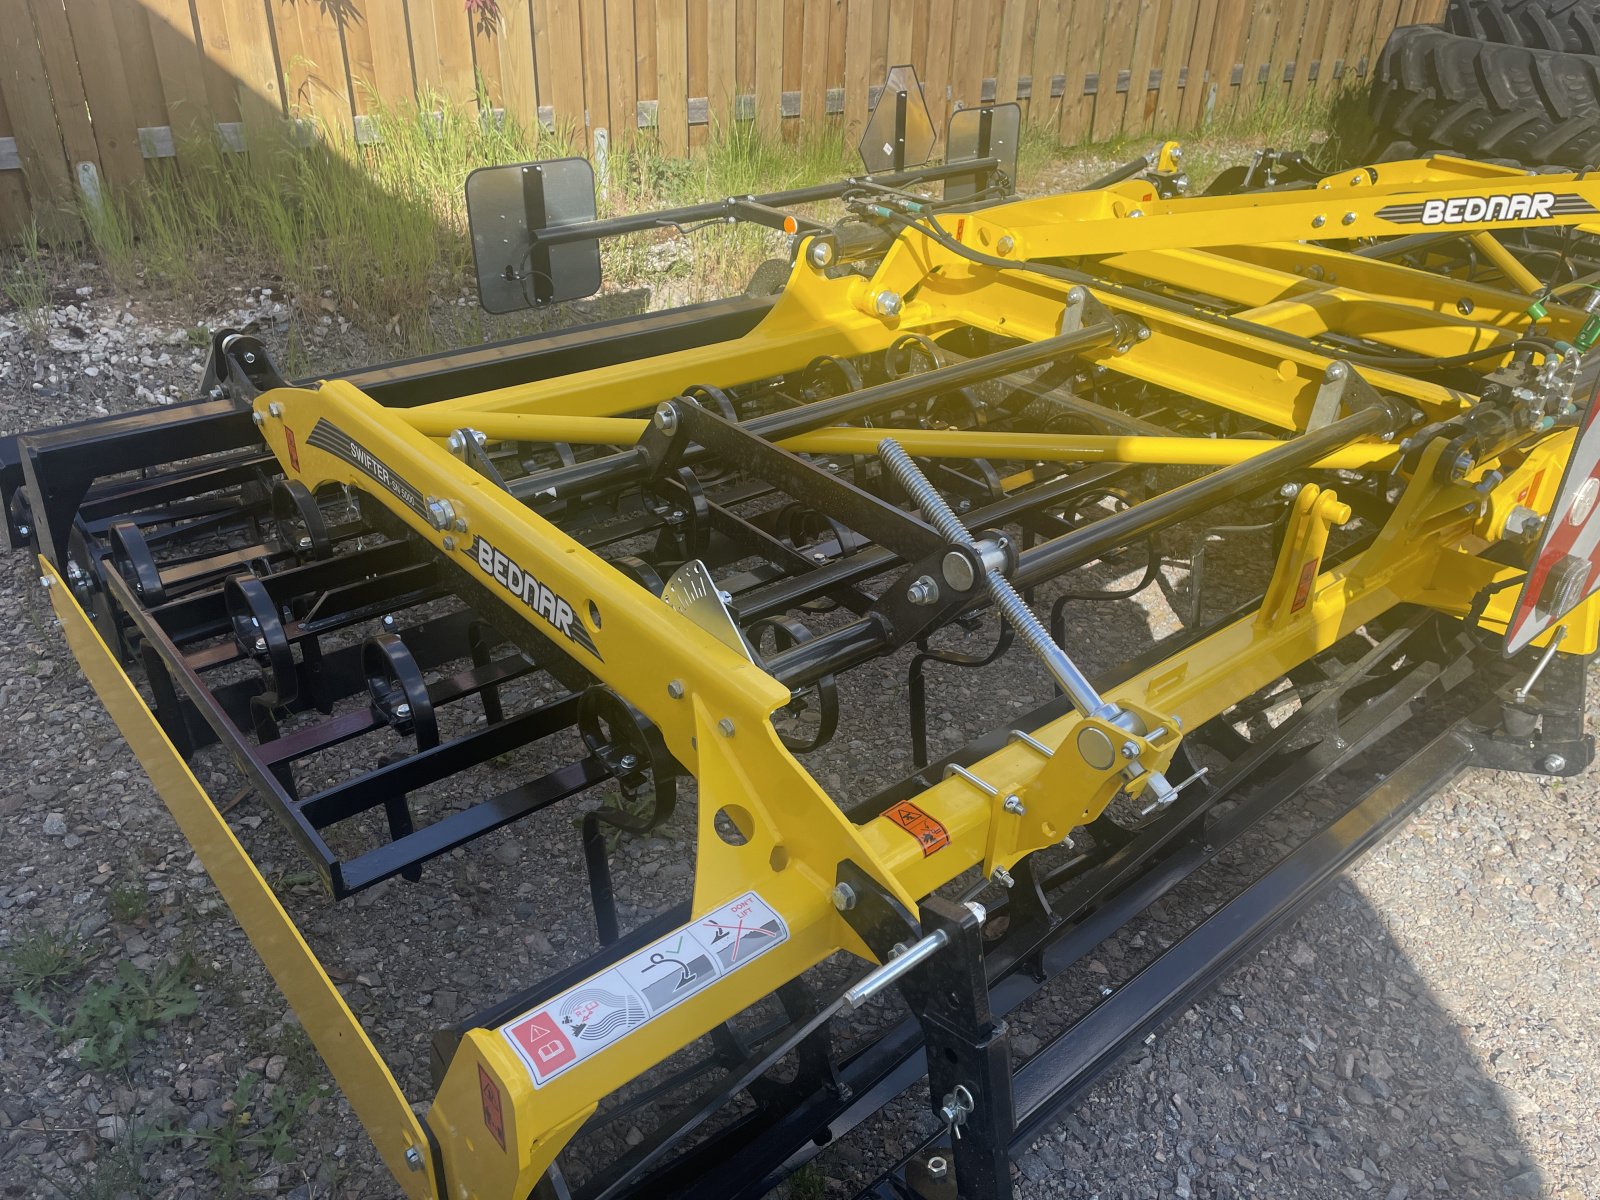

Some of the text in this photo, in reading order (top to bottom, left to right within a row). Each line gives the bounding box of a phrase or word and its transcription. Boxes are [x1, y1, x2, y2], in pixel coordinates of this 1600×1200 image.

[1420, 192, 1556, 225] BEDNAR
[350, 442, 390, 486] SWIFTER
[477, 536, 575, 640] BEDNAR
[737, 907, 753, 919] LIFT
